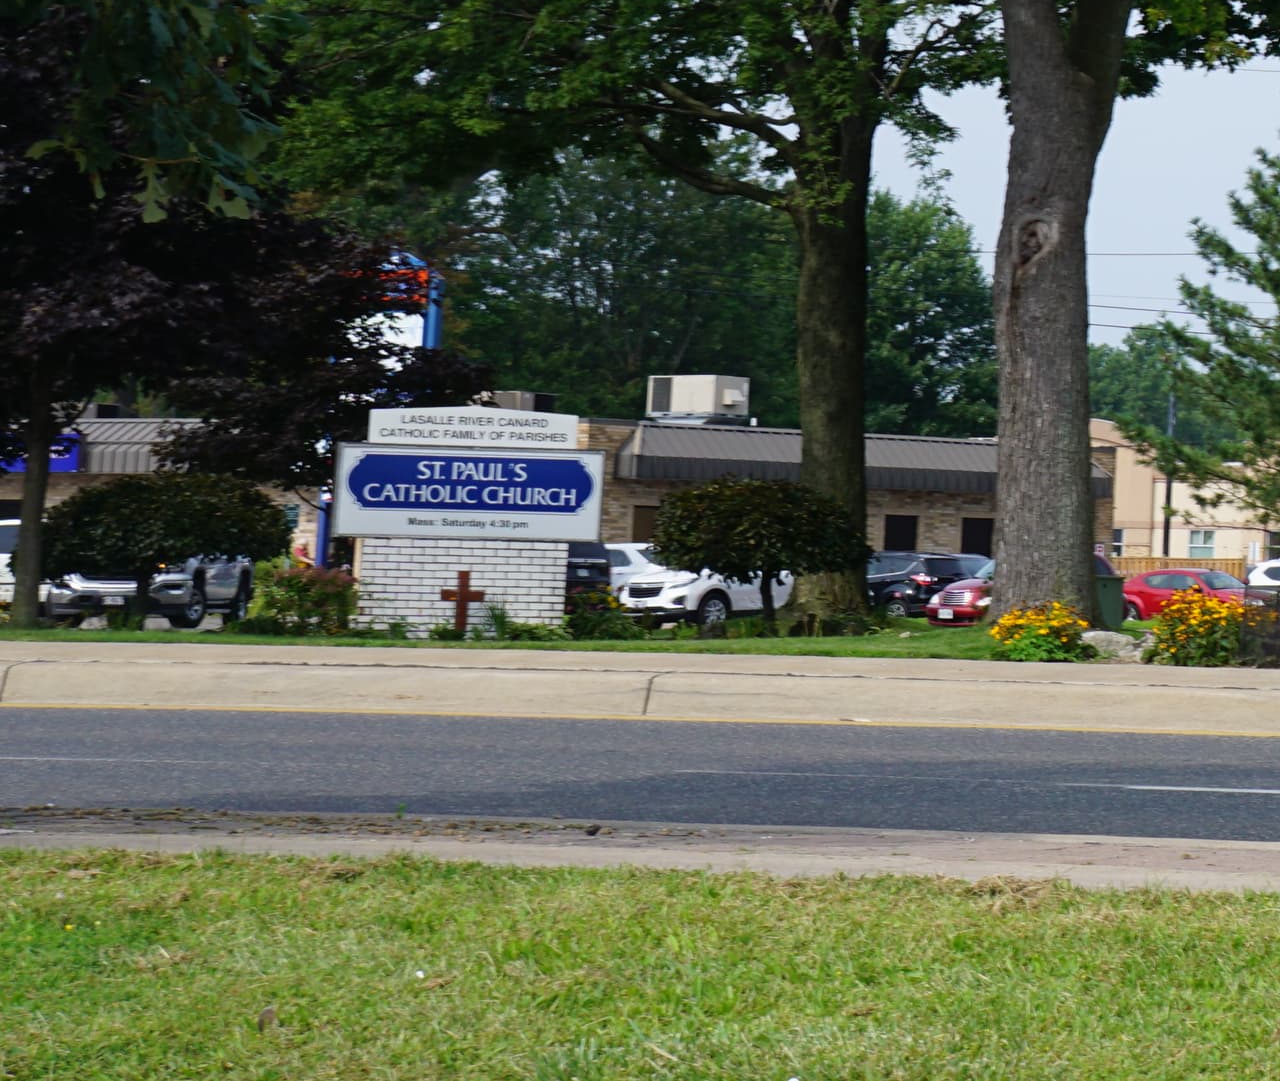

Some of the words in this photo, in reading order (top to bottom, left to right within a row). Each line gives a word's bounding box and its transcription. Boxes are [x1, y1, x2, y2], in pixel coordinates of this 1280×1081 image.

[401, 415, 454, 425] LASALLE
[458, 416, 495, 427] RIVER
[498, 417, 549, 428] CANARD
[379, 427, 441, 439] CATHOLIC
[443, 429, 486, 440] FAMILY
[489, 431, 505, 441] OF
[509, 431, 568, 442] PARISHES
[417, 461, 446, 480] ST.
[362, 483, 479, 504] CATHOLIC
[481, 486, 577, 507] CHURCH
[441, 518, 487, 529] Saturday
